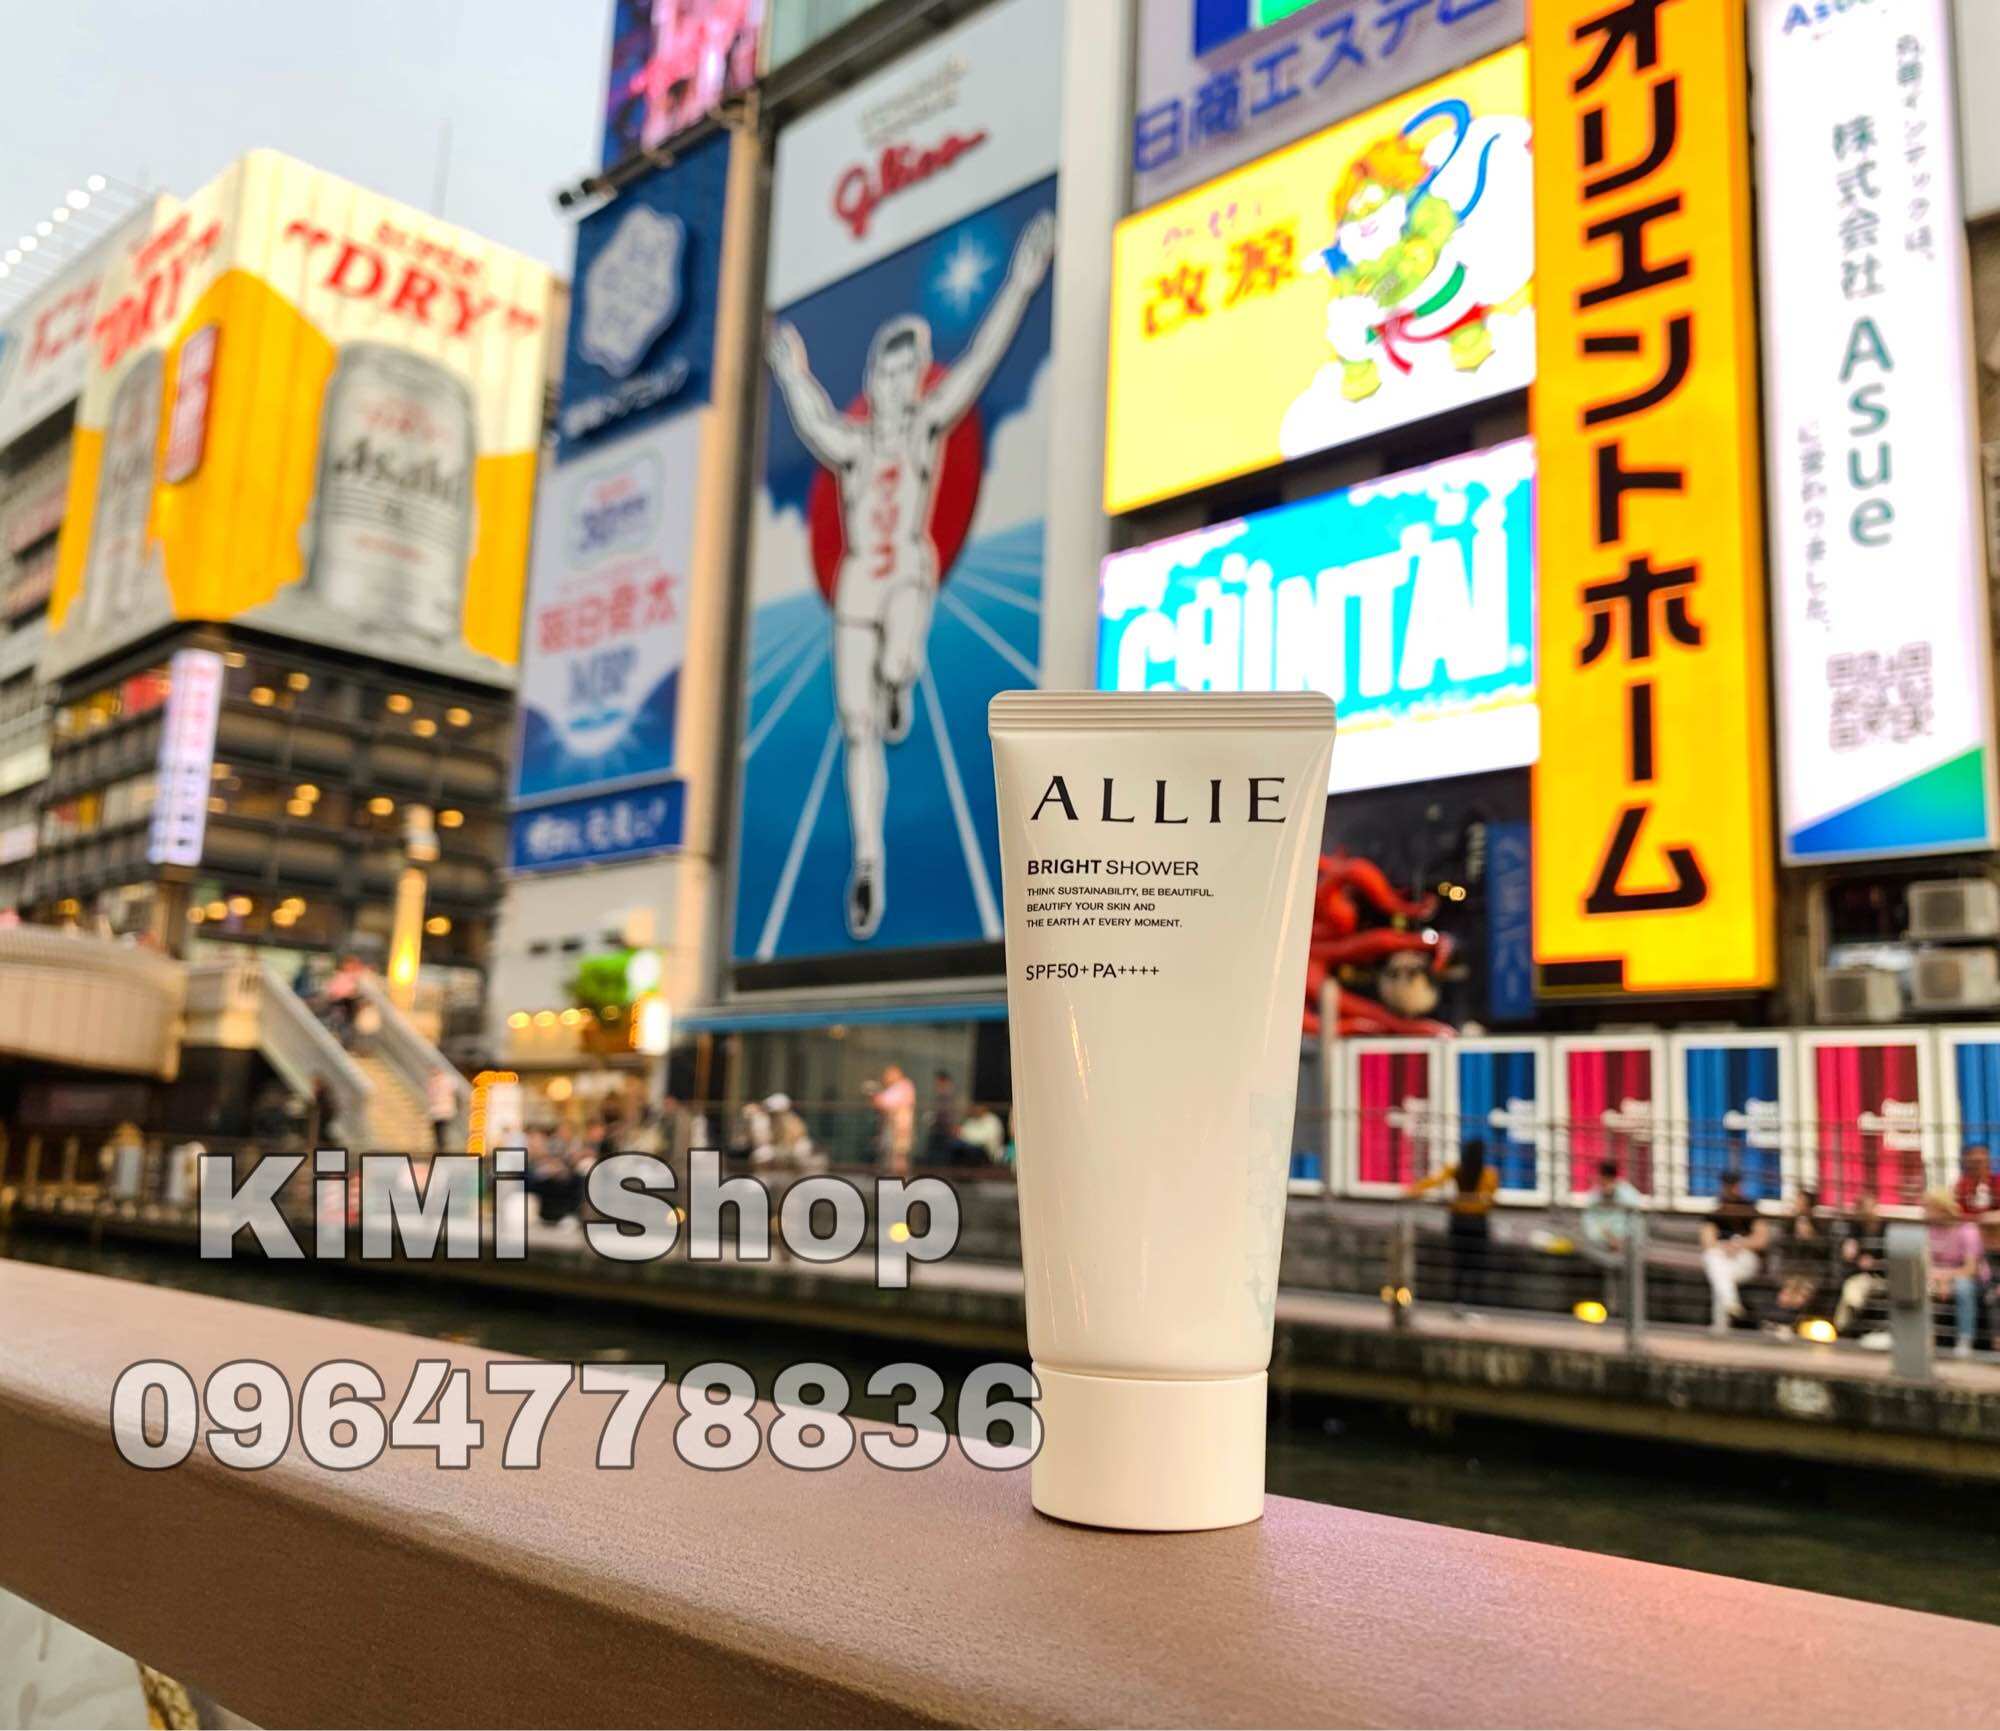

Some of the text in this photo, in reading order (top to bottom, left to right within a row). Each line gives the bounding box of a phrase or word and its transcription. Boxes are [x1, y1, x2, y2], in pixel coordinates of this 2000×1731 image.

[833, 128, 989, 242] Glico
[1832, 115, 1896, 548] 株式会社 Asue
[1573, 0, 1709, 915] オリエントホーム
[1030, 775, 1287, 824] ALLIE
[1027, 859, 1199, 877] BRIGHT SHOWER
[1026, 886, 1216, 898] THINK SUSTAINABILITY, BE BEAUTIFUL.
[1026, 901, 1156, 913] BEAUTIFY YOUR SKIN AND
[1025, 917, 1184, 929] THE EARTH AT EVERY MOMENT.
[1025, 962, 1160, 982] SPF50+ PA++++
